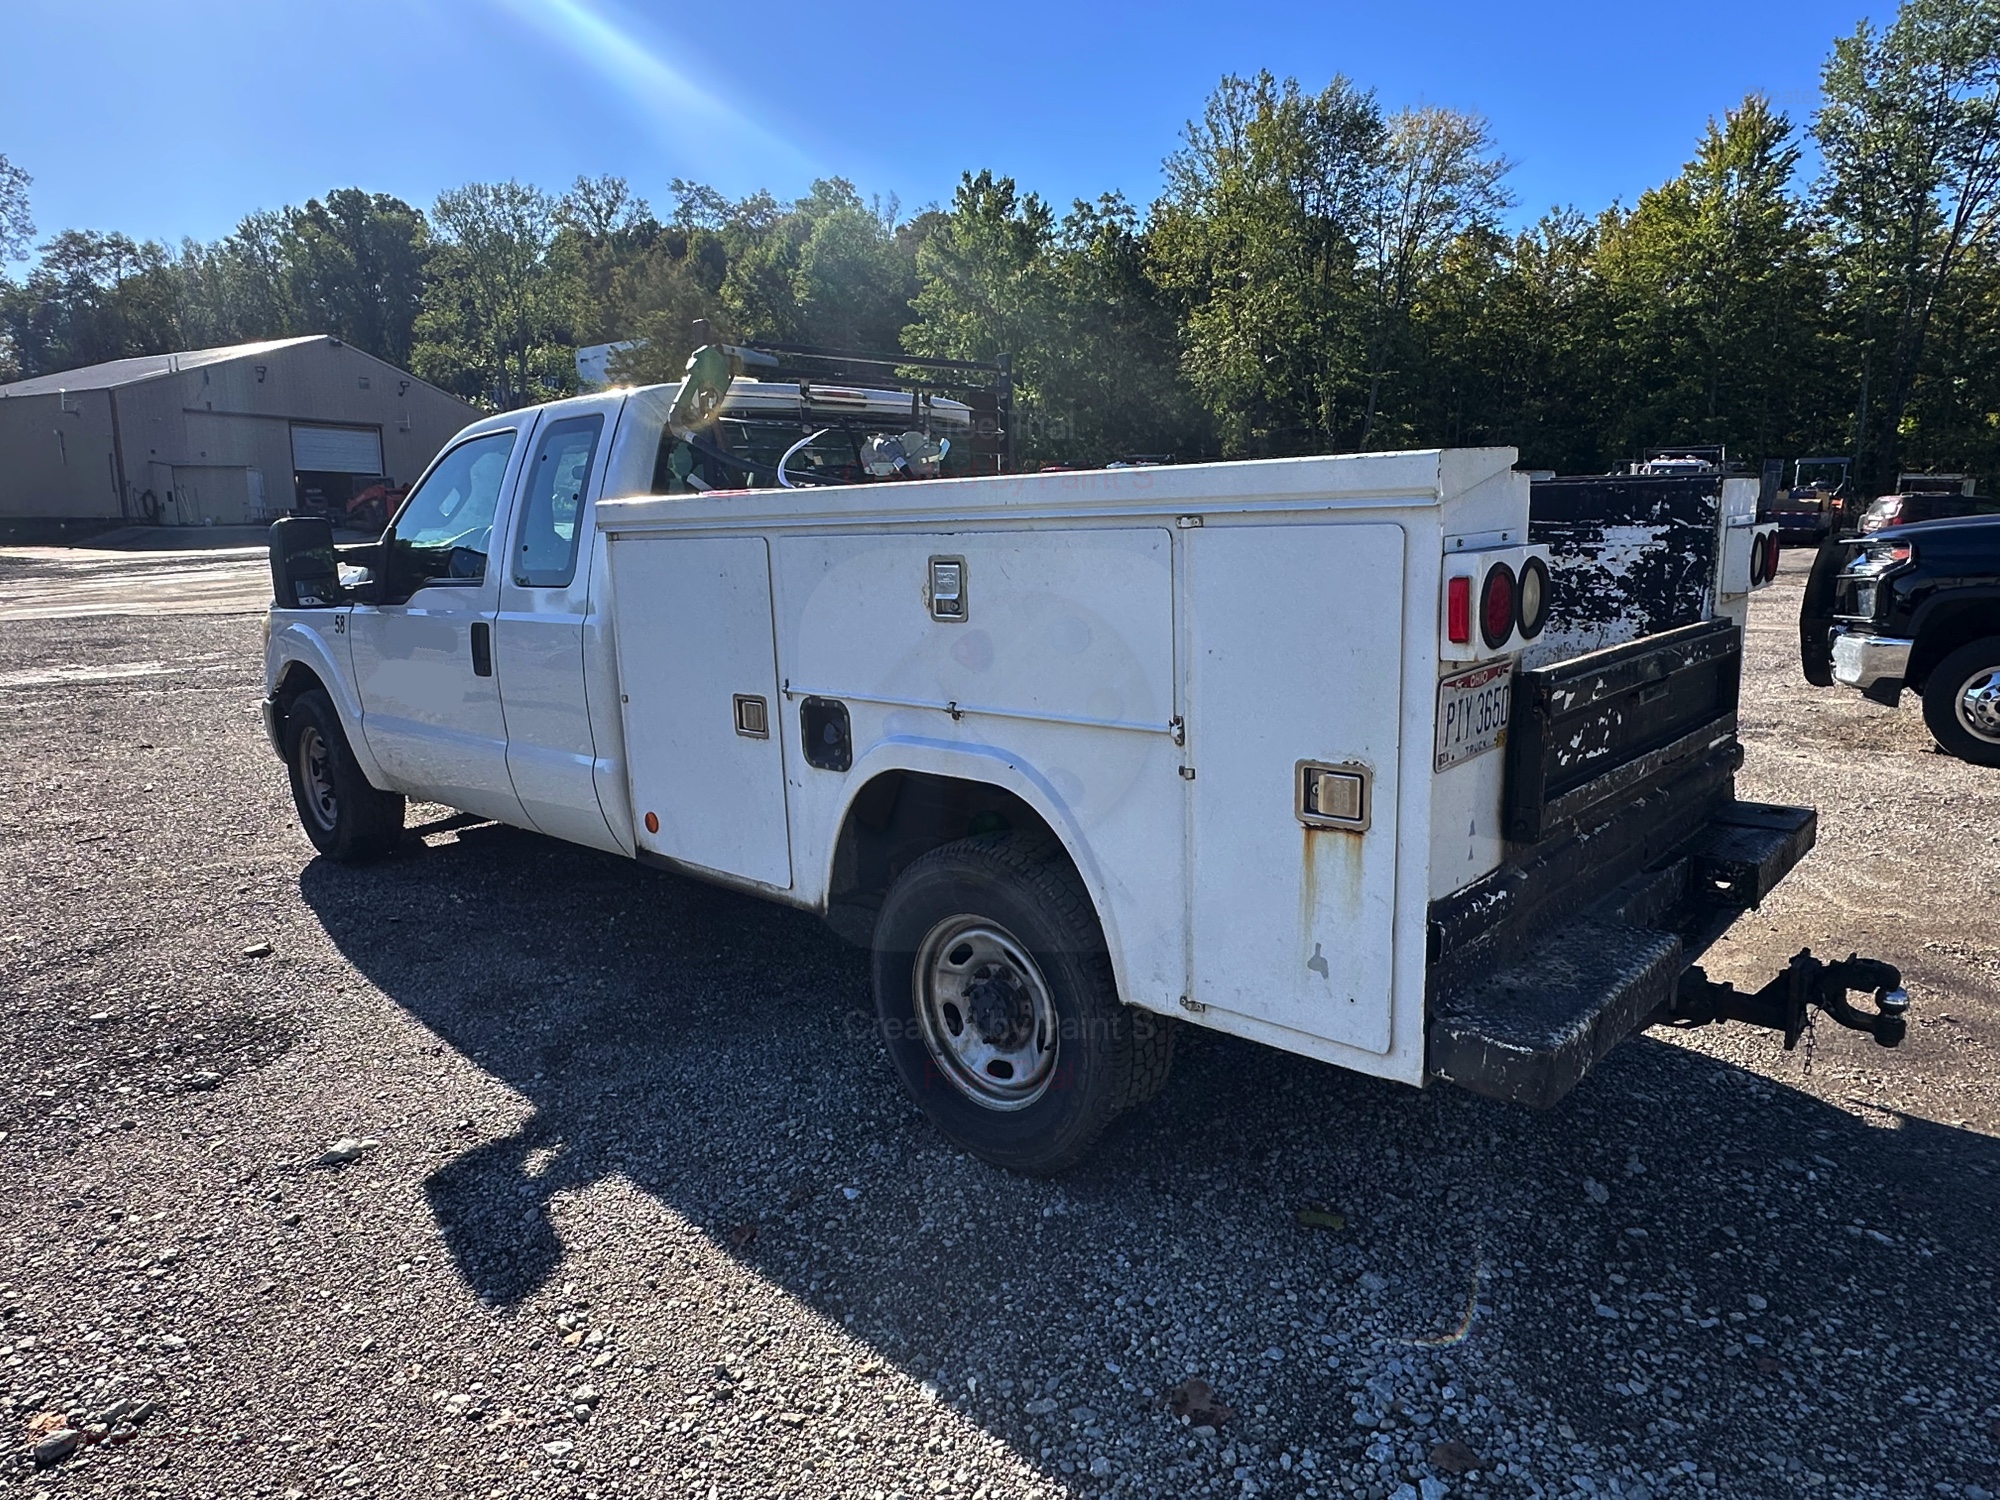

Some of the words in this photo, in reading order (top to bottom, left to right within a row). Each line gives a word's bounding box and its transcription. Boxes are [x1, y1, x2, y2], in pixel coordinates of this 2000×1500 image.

[334, 614, 345, 634] 58
[1470, 671, 1488, 686] OHIO
[1444, 695, 1473, 747] PIY
[1464, 740, 1487, 755] TRUCK
